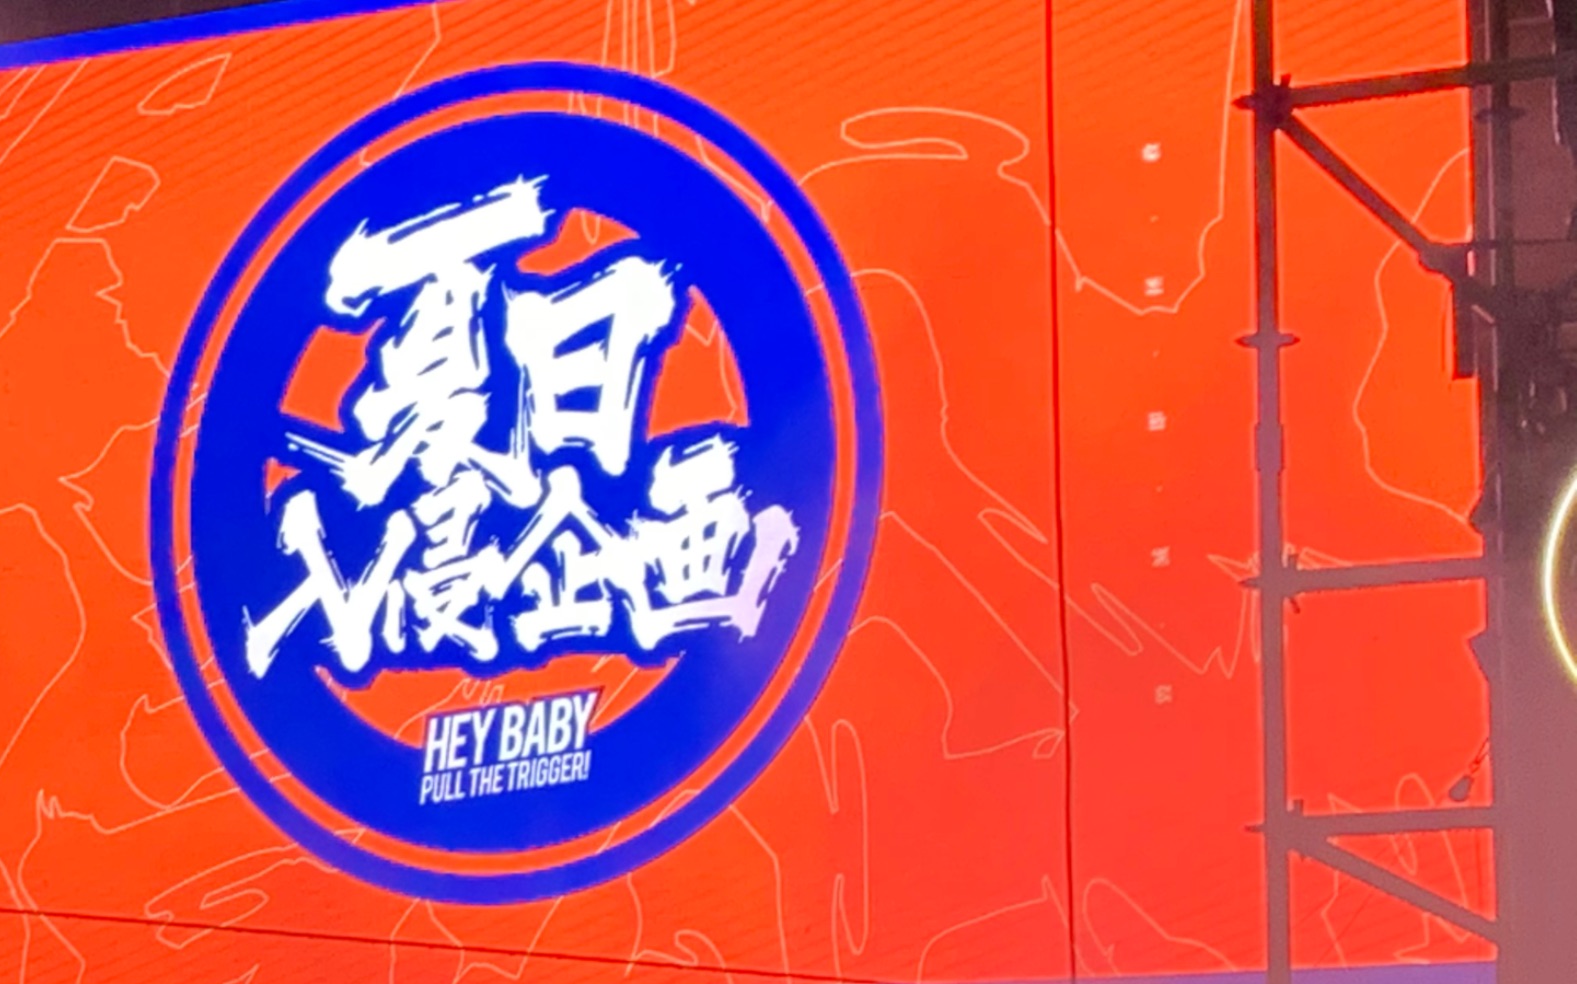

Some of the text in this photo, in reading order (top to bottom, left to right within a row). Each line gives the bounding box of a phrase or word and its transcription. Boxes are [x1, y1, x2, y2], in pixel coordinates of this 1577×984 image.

[286, 174, 681, 509] 夏日
[243, 436, 799, 679] 入侵企画
[419, 750, 592, 806] PULL THE TRIGGER!
[424, 691, 598, 774] HEY BABY
